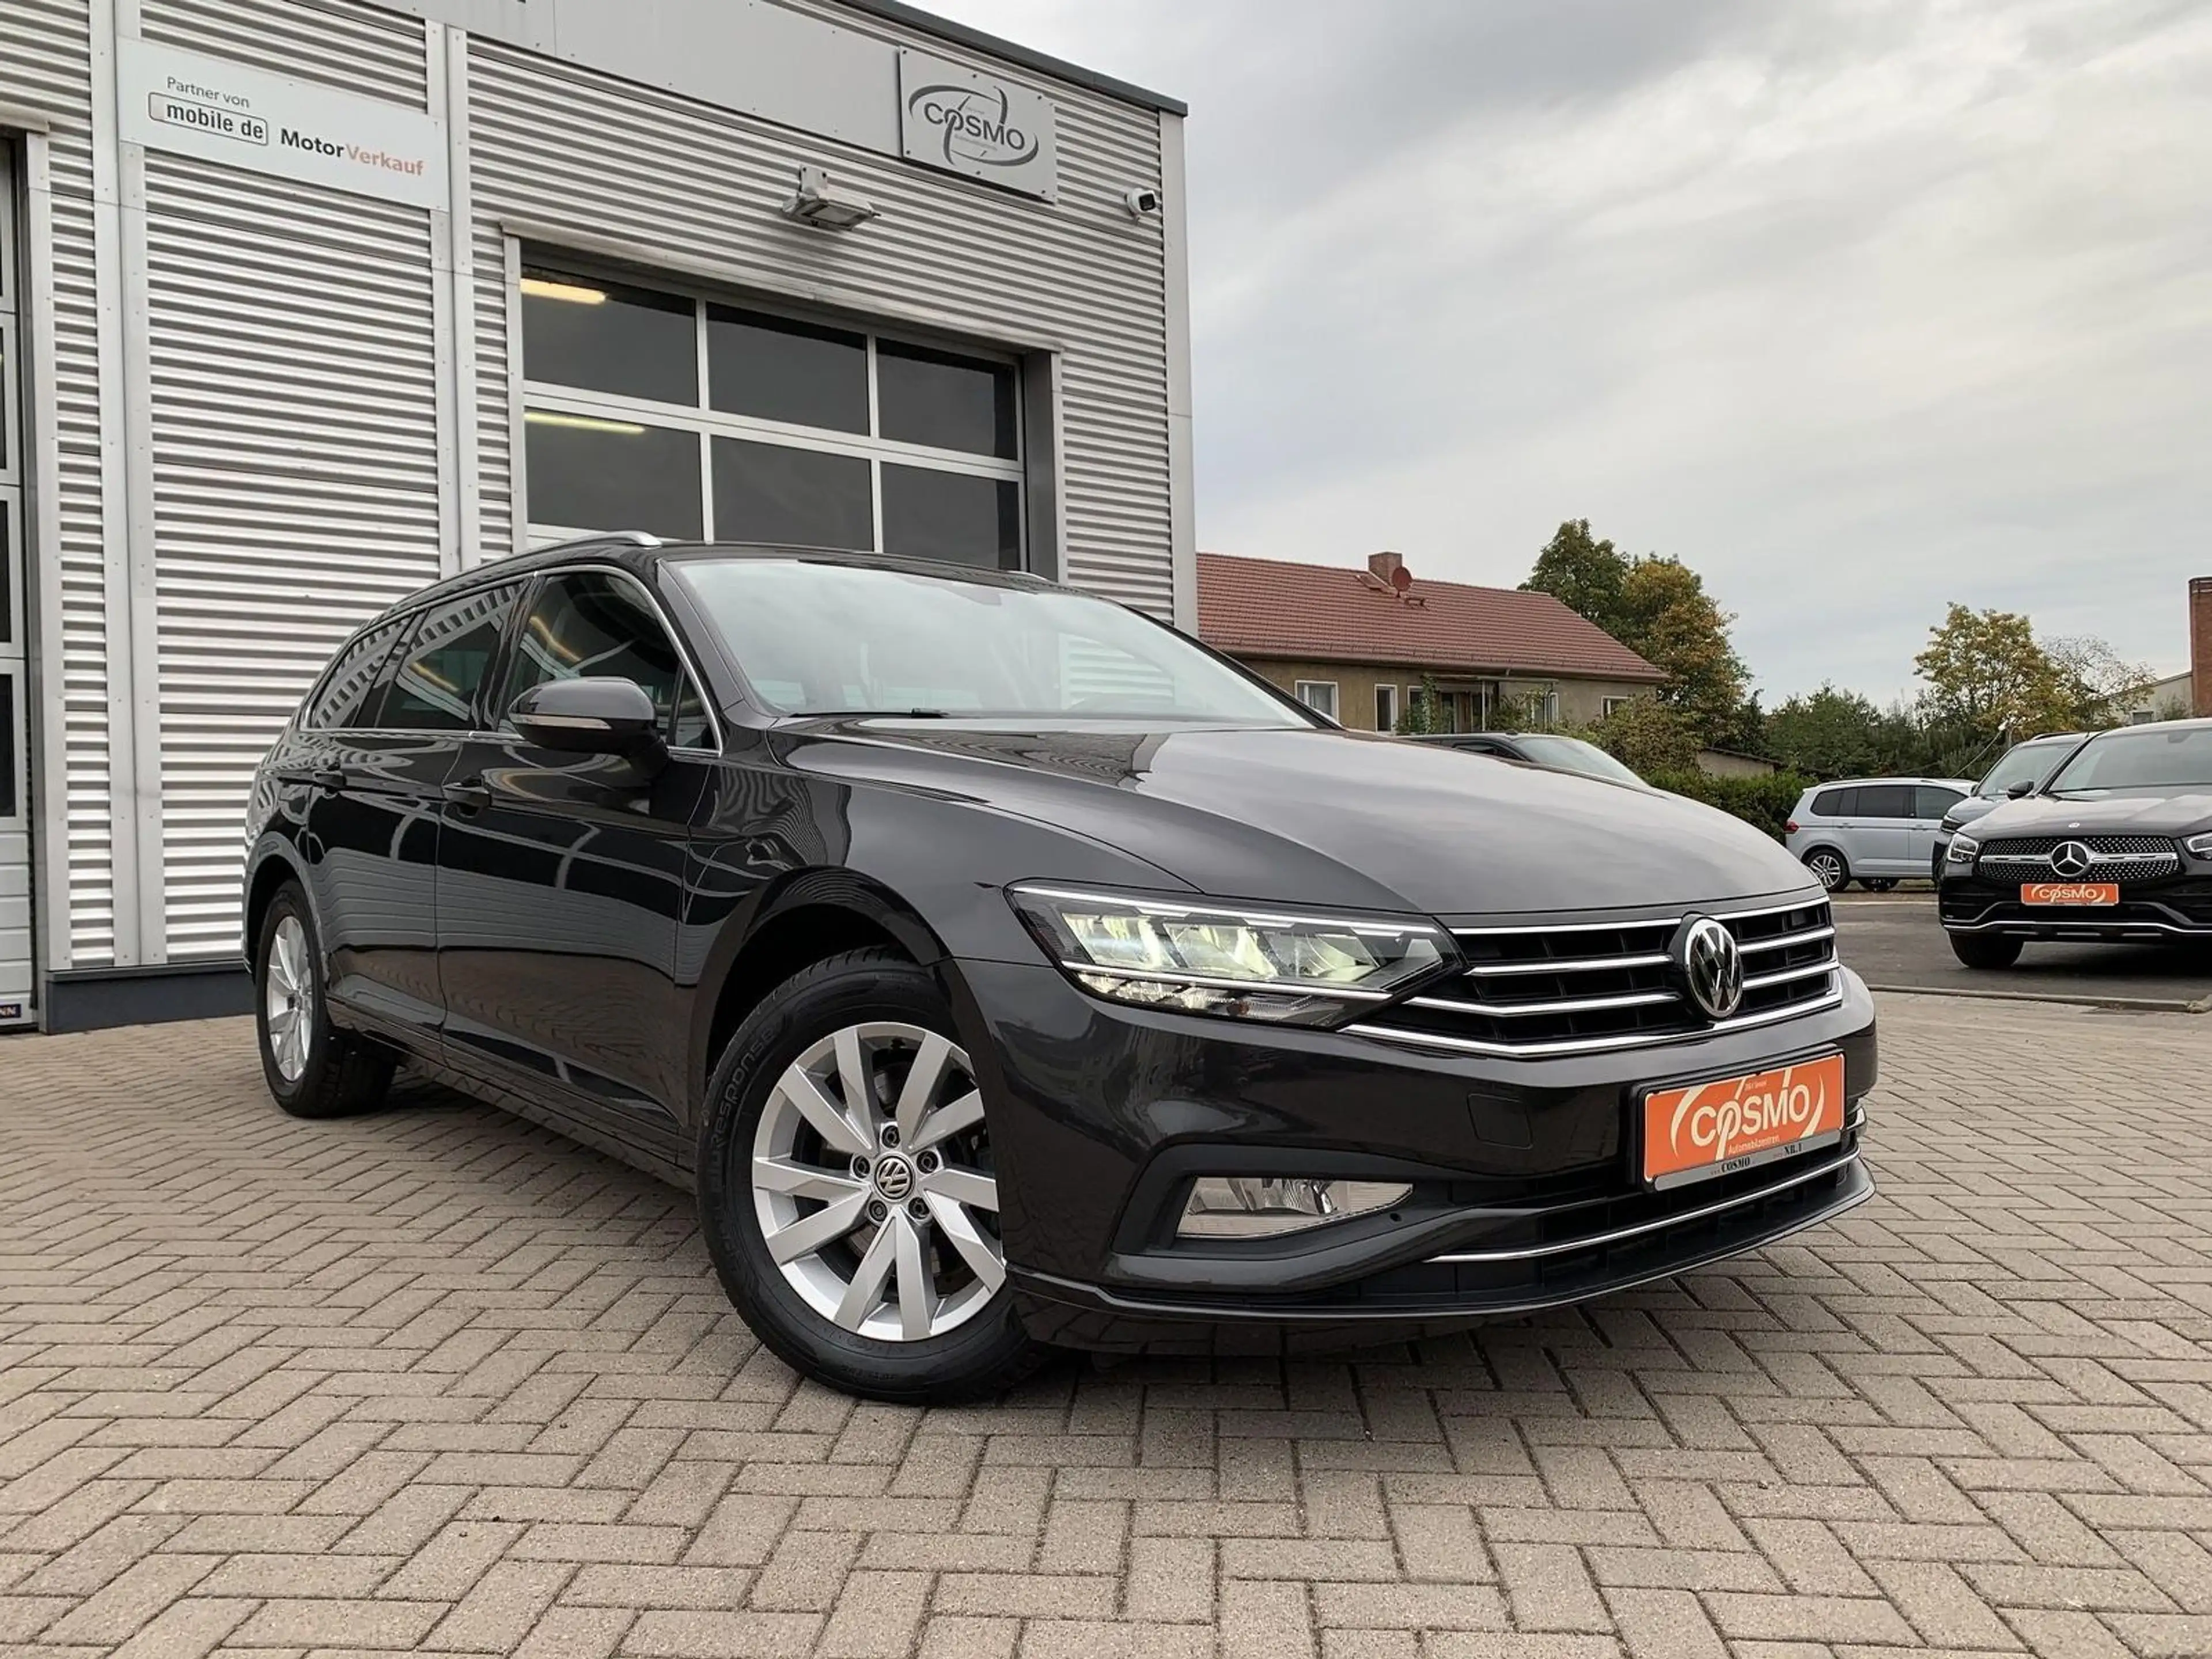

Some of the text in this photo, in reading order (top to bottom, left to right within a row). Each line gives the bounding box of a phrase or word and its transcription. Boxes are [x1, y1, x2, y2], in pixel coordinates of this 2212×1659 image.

[167, 76, 249, 109] Partner von
[166, 101, 424, 176] mobile de MotorVerkauf
[924, 103, 1025, 150] COSMO
[2039, 888, 2097, 899] COSMO
[1691, 1084, 1810, 1147] COSMO
